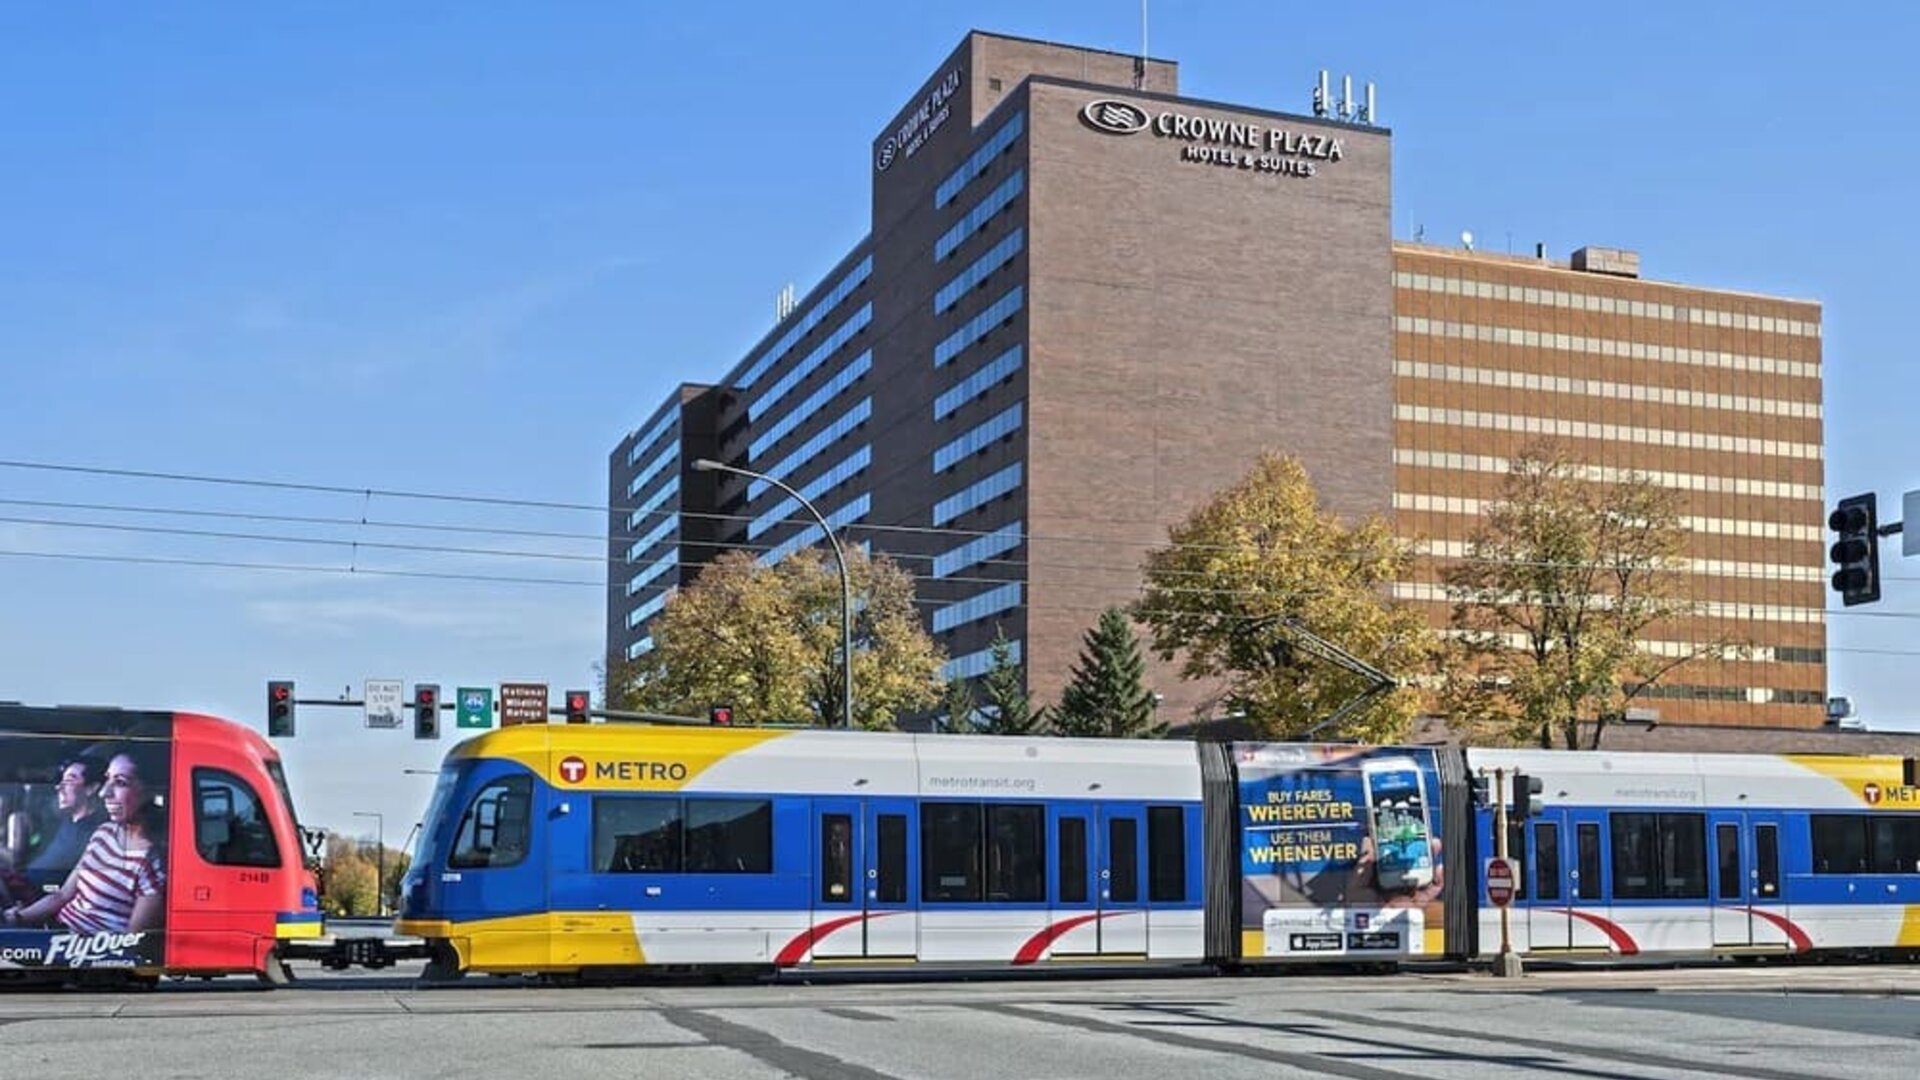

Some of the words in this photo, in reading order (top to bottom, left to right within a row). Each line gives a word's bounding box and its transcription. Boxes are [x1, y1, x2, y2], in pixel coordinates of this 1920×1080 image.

[1157, 112, 1260, 148] CROWNE
[1269, 128, 1344, 159] PLAZA
[1187, 145, 1239, 165] HOTEL
[1244, 155, 1254, 167] &
[1260, 155, 1317, 176] SUITES
[503, 687, 546, 697] National
[506, 698, 543, 707] Wildlife
[506, 708, 542, 720] Refuge
[596, 761, 687, 781] METRO
[929, 776, 1036, 792] metrotransit.org
[1267, 791, 1293, 803] BUY
[1295, 789, 1333, 802] FARES
[1248, 802, 1353, 821] WHEREVER
[1270, 831, 1295, 845] USE
[1297, 830, 1331, 842] THEM
[1249, 843, 1358, 864] WHENEVER
[43, 931, 146, 968] FlyOver
